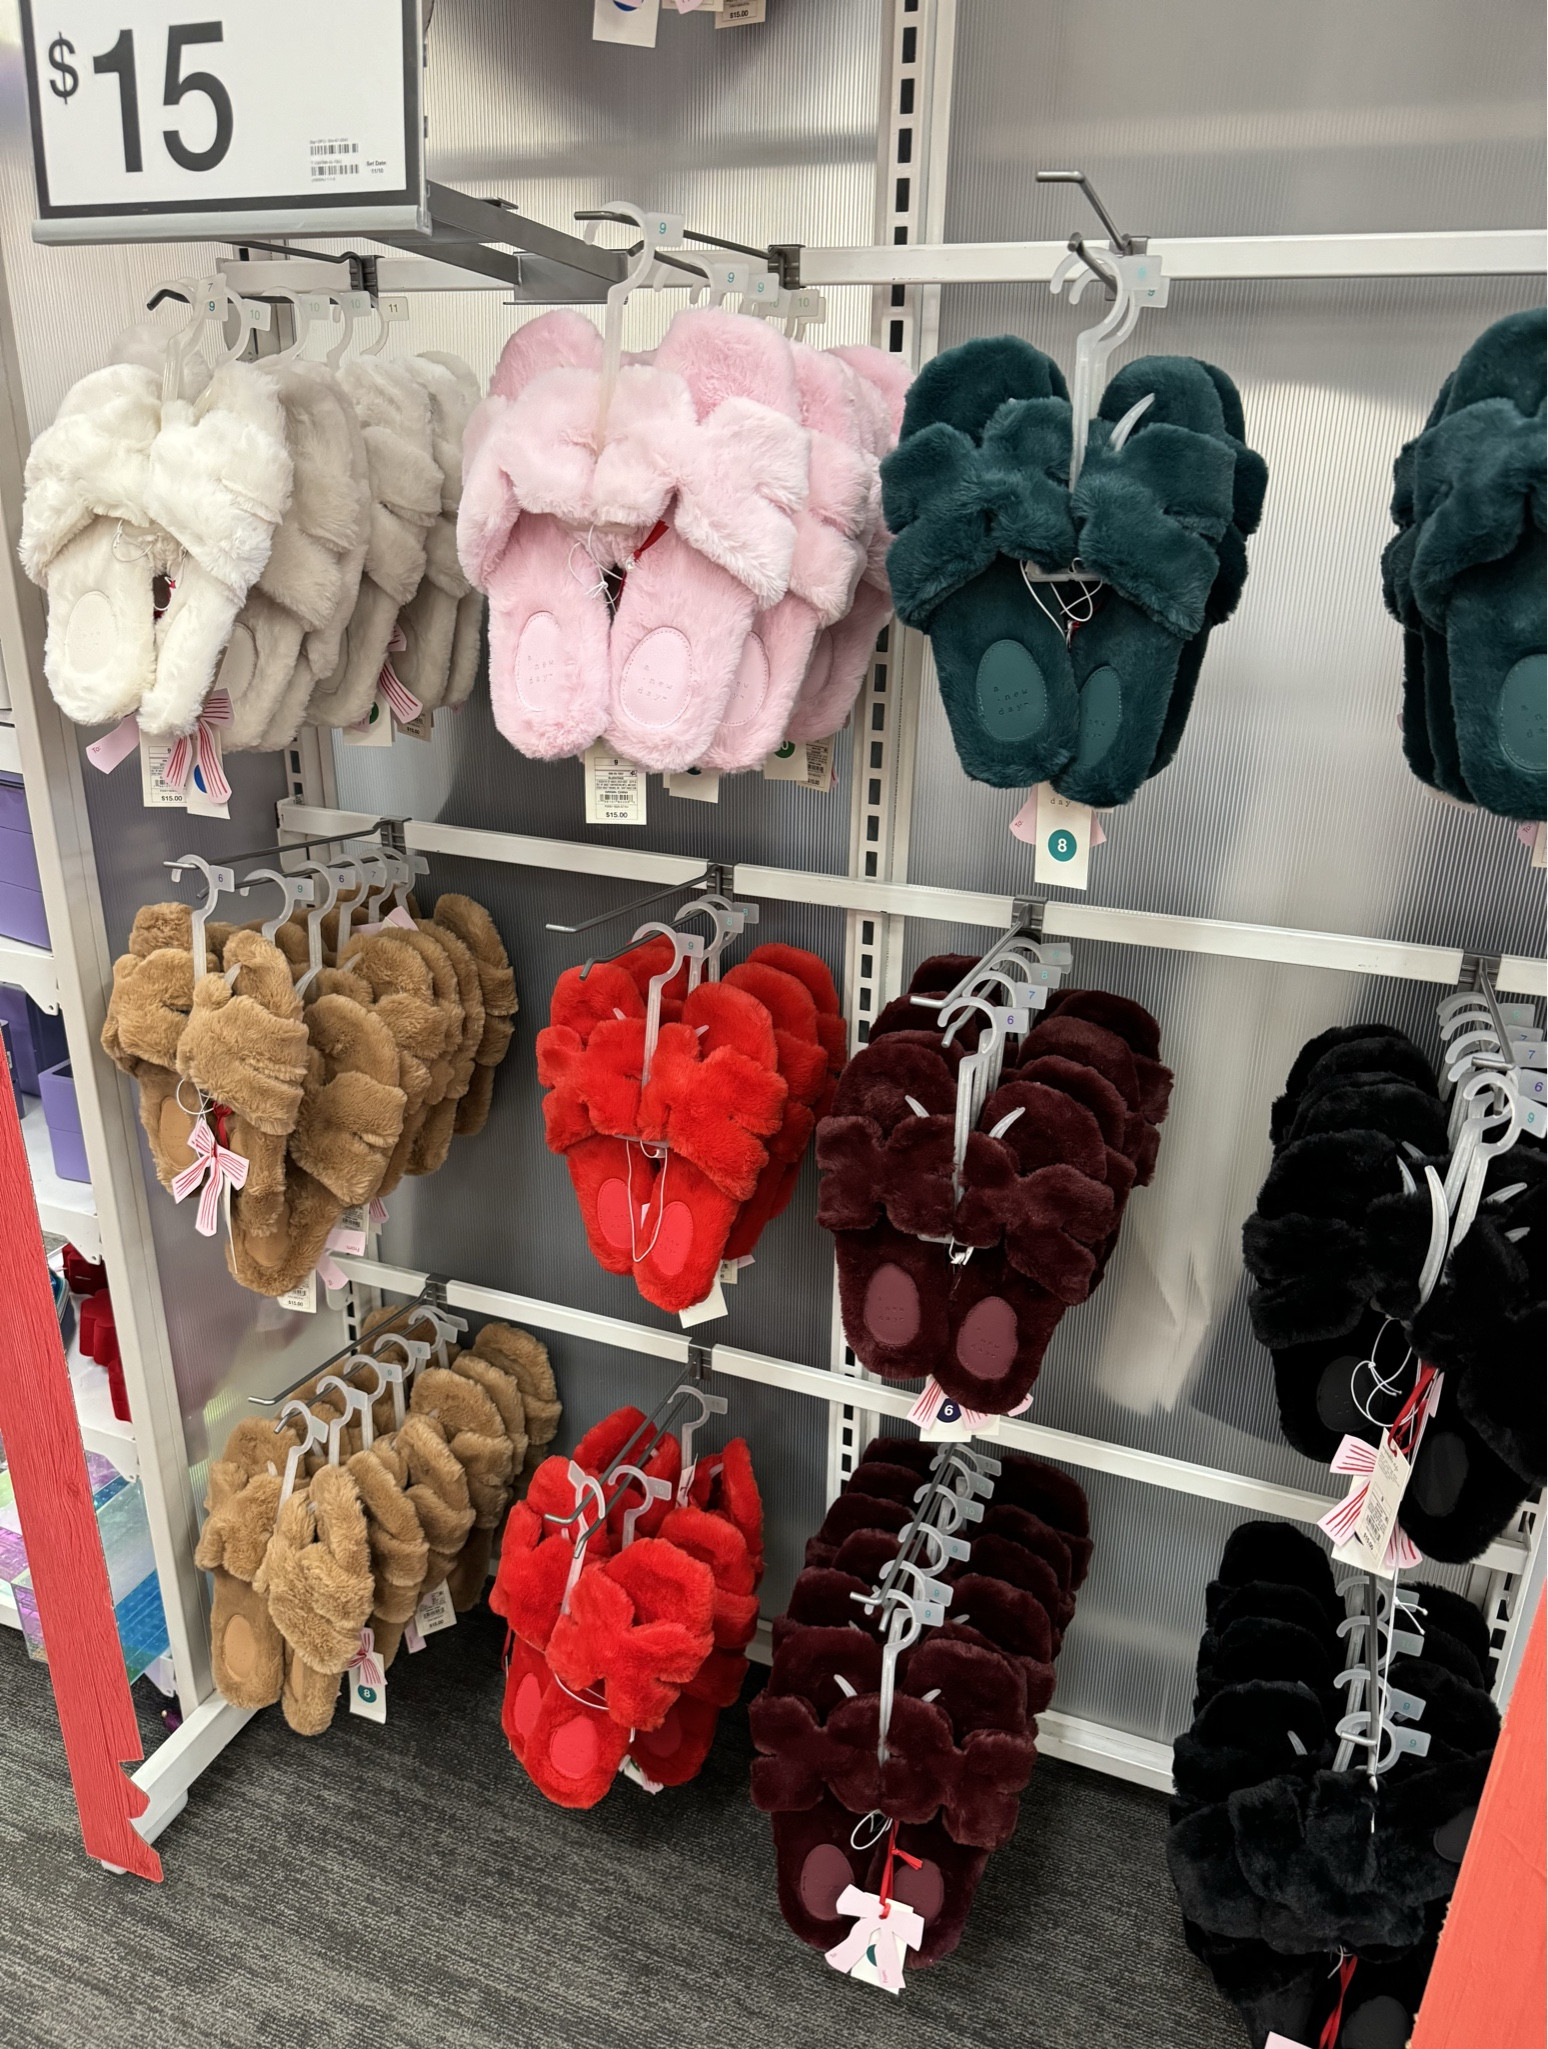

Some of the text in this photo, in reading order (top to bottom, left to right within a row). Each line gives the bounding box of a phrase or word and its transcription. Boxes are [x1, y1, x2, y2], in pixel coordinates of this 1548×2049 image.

[729, 9, 749, 19] $15.00
[659, 221, 667, 234] 9
[728, 271, 735, 283] 9
[207, 282, 214, 292] 7
[757, 282, 765, 293] 9
[208, 300, 216, 312] 9
[309, 302, 320, 312] 10
[351, 298, 361, 309] 10
[388, 303, 399, 313] 11
[250, 309, 261, 321] 10
[1050, 798, 1071, 808] day
[1057, 838, 1067, 853] 8
[218, 873, 224, 883] 6
[338, 874, 345, 883] 6
[297, 884, 303, 894] 9
[688, 941, 694, 950] 9
[1028, 990, 1036, 1000] 7
[1007, 1015, 1014, 1025] 6
[1528, 1049, 1536, 1060] 7
[1534, 1081, 1543, 1093] 6
[1527, 1112, 1535, 1123] 9
[943, 1404, 954, 1416] 6
[965, 1504, 976, 1515] 10
[924, 1609, 932, 1618] 9
[363, 1688, 371, 1699] 8
[1402, 1702, 1411, 1711] 9
[1409, 1738, 1417, 1748] 9
